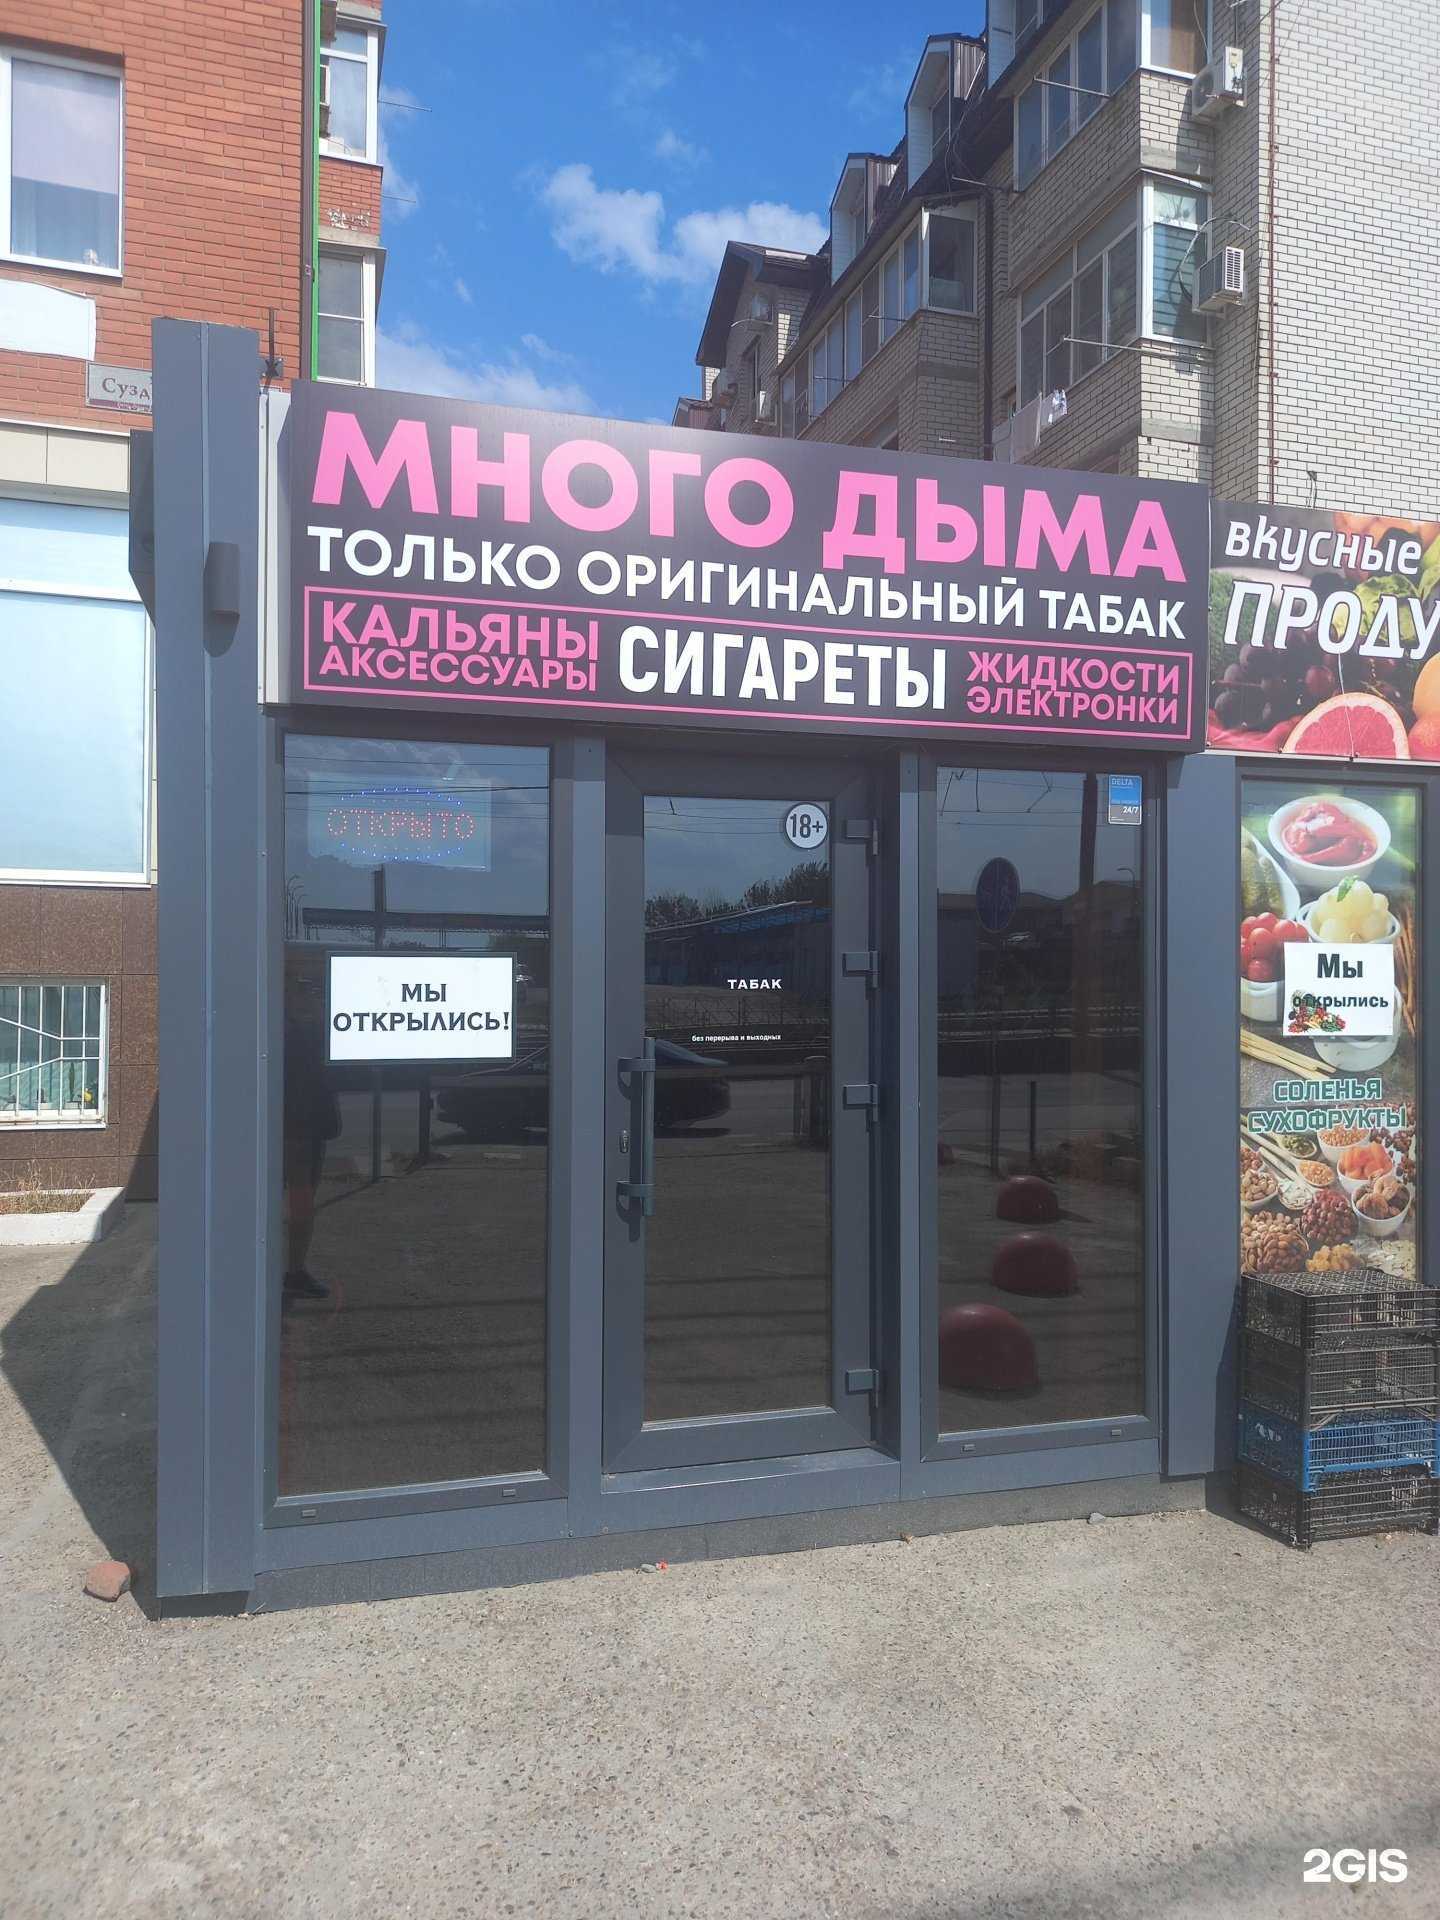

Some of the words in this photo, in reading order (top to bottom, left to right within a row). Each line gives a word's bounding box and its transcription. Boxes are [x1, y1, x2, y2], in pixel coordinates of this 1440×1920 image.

[312, 411, 795, 548] МНОГО
[822, 470, 1187, 582] ДЫМА
[307, 526, 561, 590] ТОЛЬКО
[577, 551, 1024, 627] ОРИГИНАЛЬНЫЙ
[1039, 589, 1186, 640] ТАБАК
[322, 600, 598, 660] КАЛЬЯНЫ
[319, 645, 597, 691] АКСЕССУАРЫ
[619, 625, 946, 710] СИГАРЕТЫ
[967, 651, 1179, 694] ЖИДКОСТИ
[966, 686, 1178, 724] ЭЛЕКТРОНКИ
[1122, 806, 1139, 814] 24/7
[327, 809, 475, 840] ОТКРЫТО
[790, 813, 824, 838] 18+
[1317, 953, 1363, 978] Мы
[402, 983, 447, 1002] МЫ
[727, 979, 782, 989] ТАБАК
[1293, 995, 1389, 1011] окрылись
[333, 1012, 510, 1032] ОТКРЫЛИСЬ!
[691, 1034, 704, 1042] без
[1274, 1078, 1382, 1102] СОЛЕНЬЯ
[1248, 1108, 1408, 1133] СУХОФРУКТЫ
